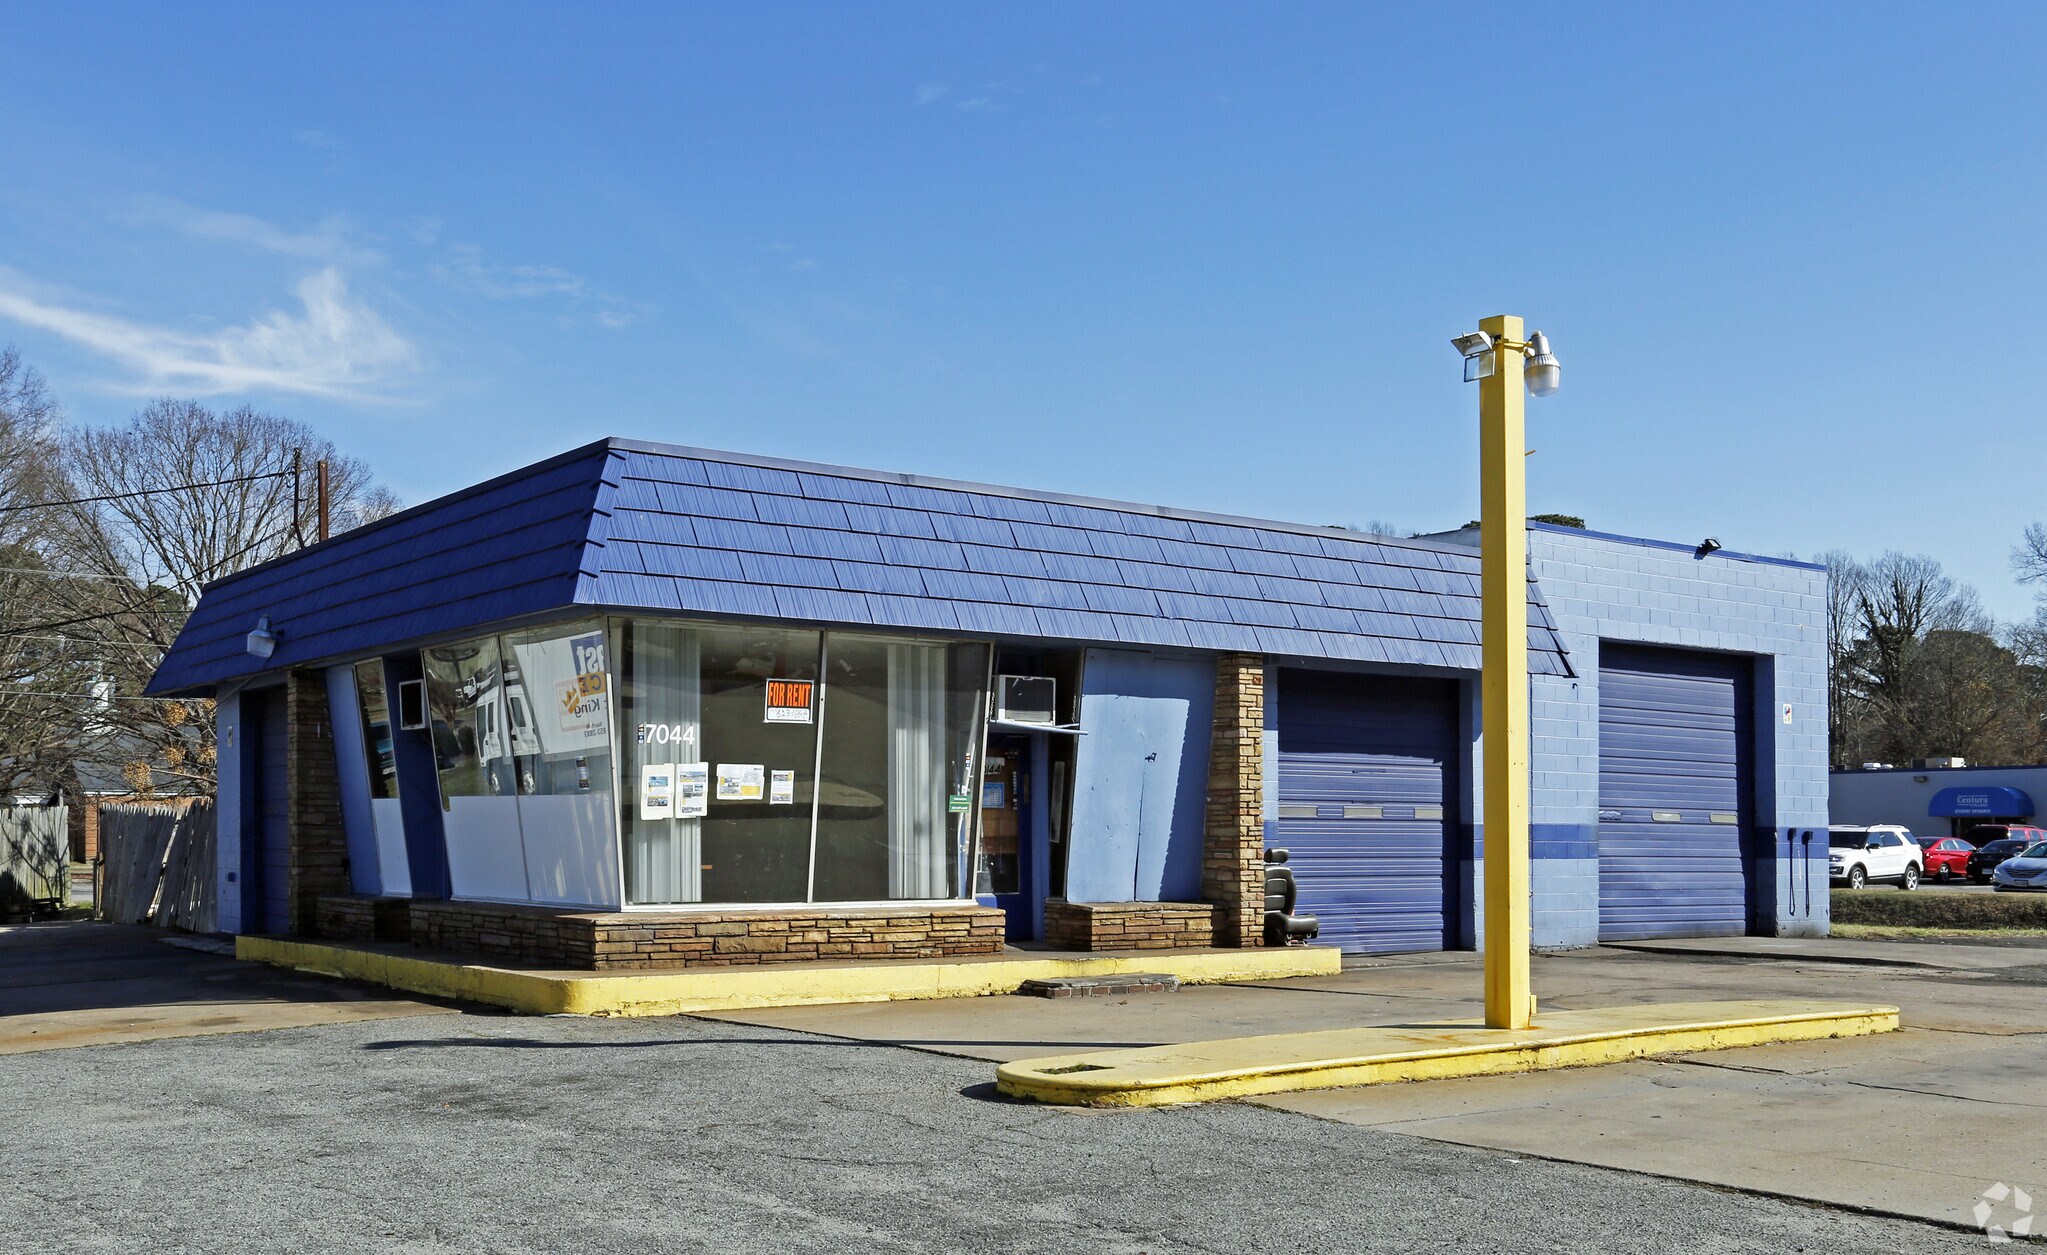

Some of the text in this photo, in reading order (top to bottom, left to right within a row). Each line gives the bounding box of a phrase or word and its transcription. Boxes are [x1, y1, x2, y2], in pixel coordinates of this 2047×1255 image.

[768, 682, 811, 707] FOR RENT
[645, 723, 696, 745] 7044
